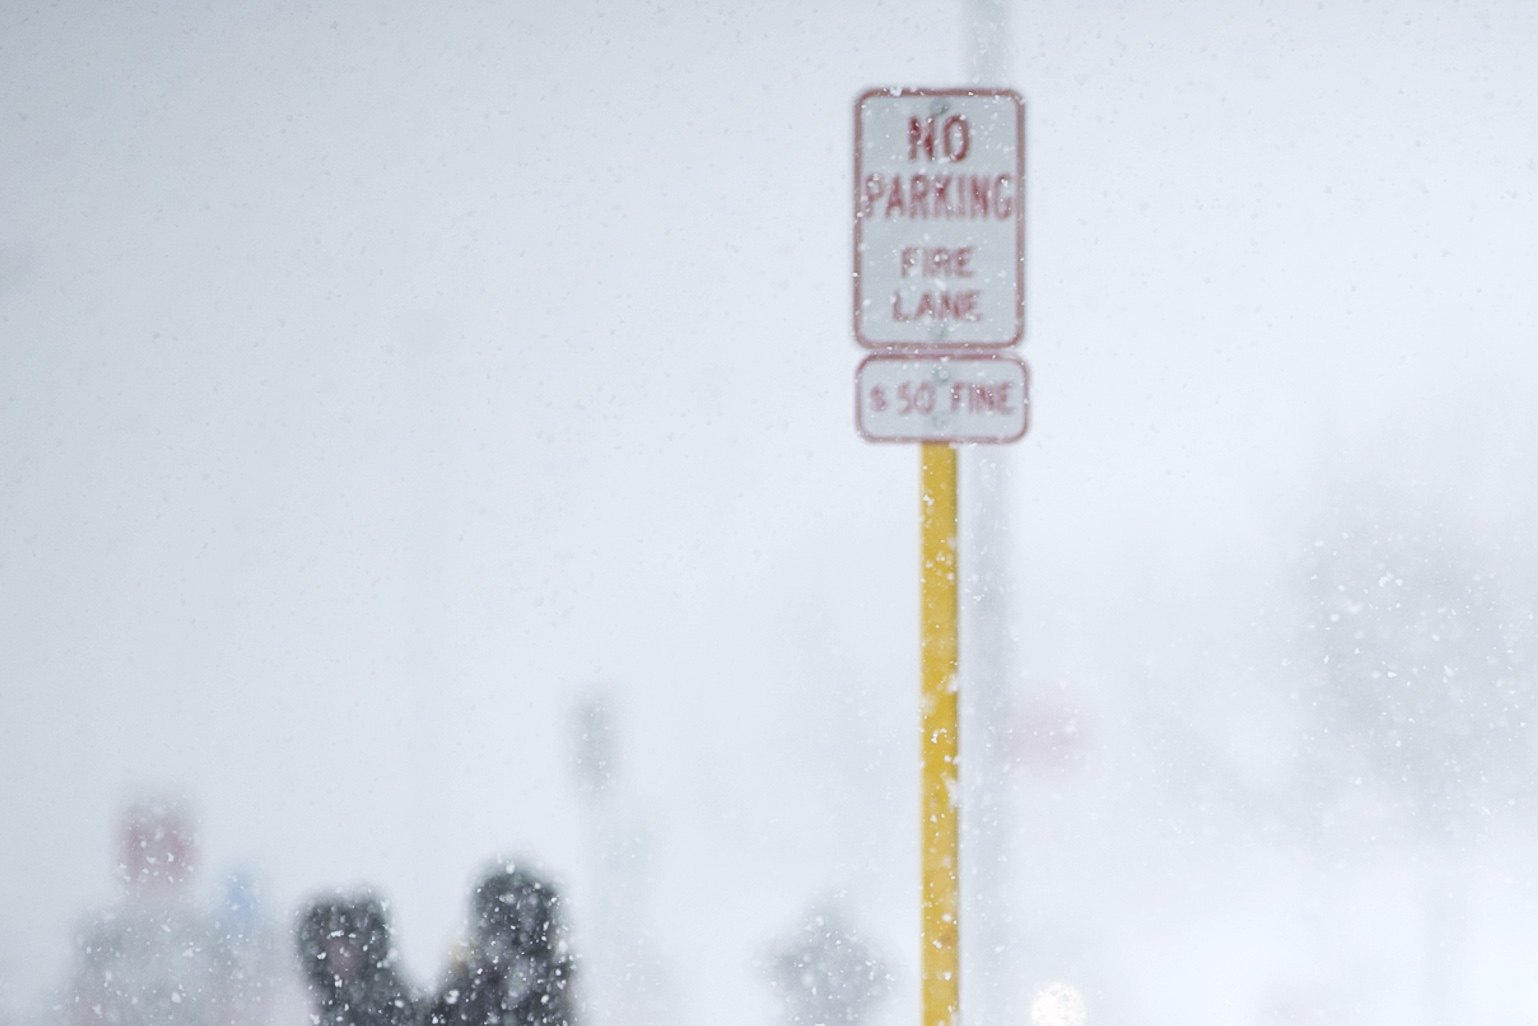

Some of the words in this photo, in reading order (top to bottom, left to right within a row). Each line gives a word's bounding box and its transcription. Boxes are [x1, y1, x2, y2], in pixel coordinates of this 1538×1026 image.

[908, 115, 970, 163] NO
[866, 174, 1012, 219] PARKING
[902, 248, 974, 277] FIRE
[893, 292, 981, 321] LANE
[951, 382, 1014, 415] FINE
